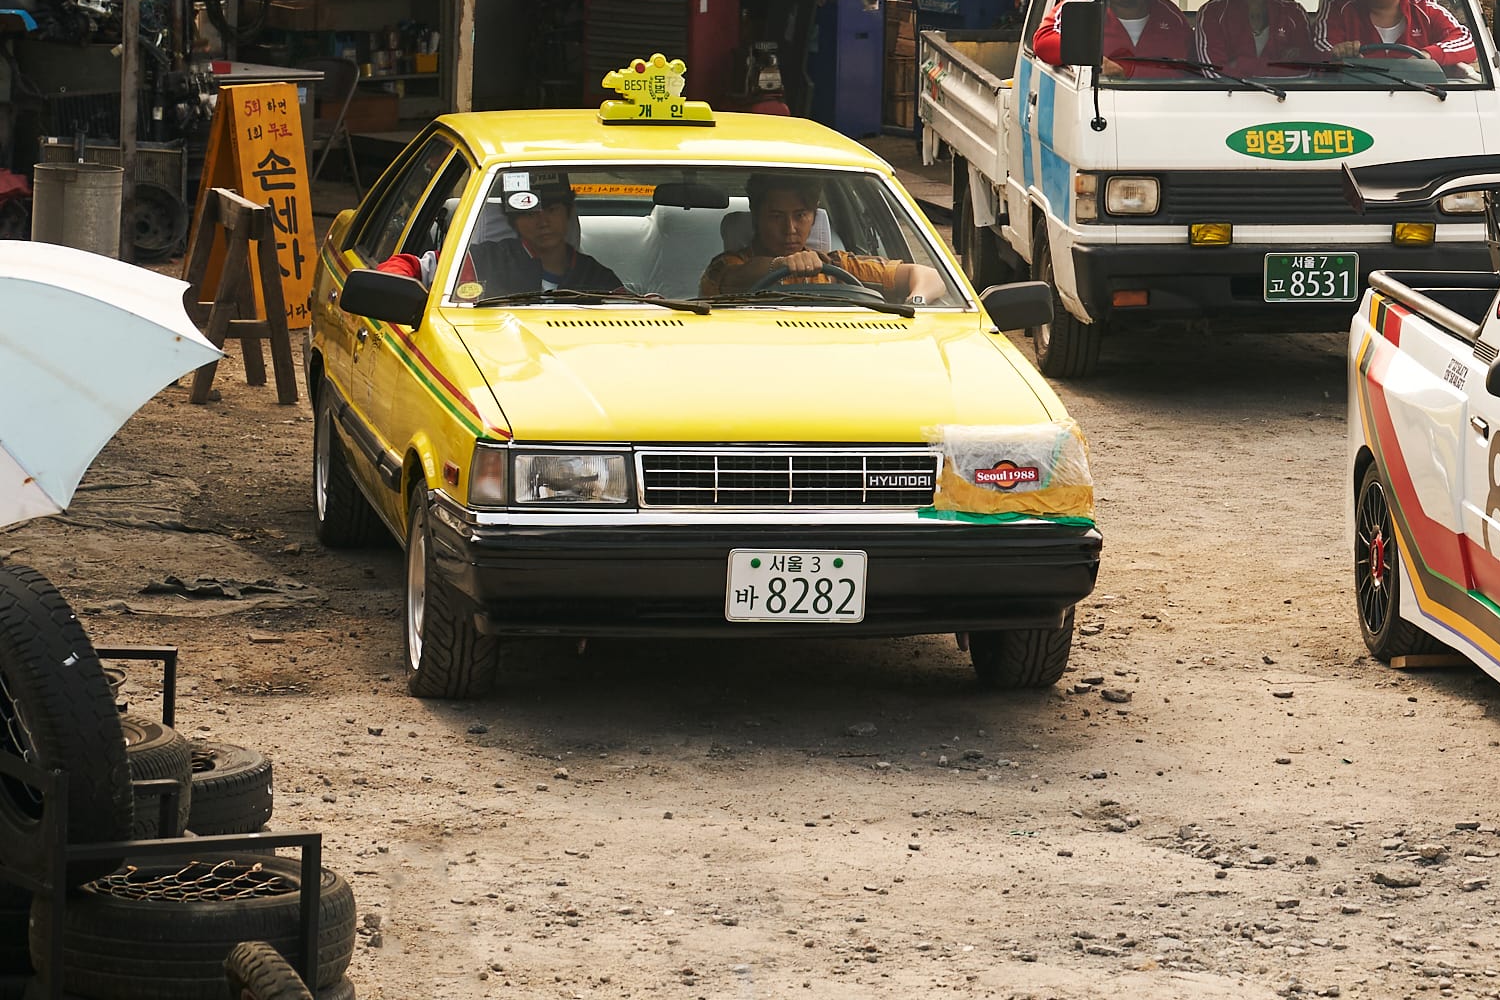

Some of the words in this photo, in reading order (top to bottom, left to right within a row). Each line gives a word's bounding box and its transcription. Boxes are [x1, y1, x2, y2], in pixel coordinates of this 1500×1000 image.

[624, 79, 648, 91] BEST
[654, 75, 666, 94] 모범
[267, 122, 293, 142] 무료
[1245, 129, 1355, 155] 희영카센타
[1291, 256, 1315, 269] 서울
[1319, 256, 1328, 269] 7
[1268, 279, 1286, 293] 고
[1290, 270, 1350, 297] 8531
[869, 474, 932, 488] HYUNDAI
[976, 469, 1007, 483] Seoul
[1008, 468, 1036, 481] 1988
[769, 554, 804, 574] 서울
[810, 556, 822, 574] 3
[735, 584, 759, 611] 바
[765, 577, 856, 616] 8282
